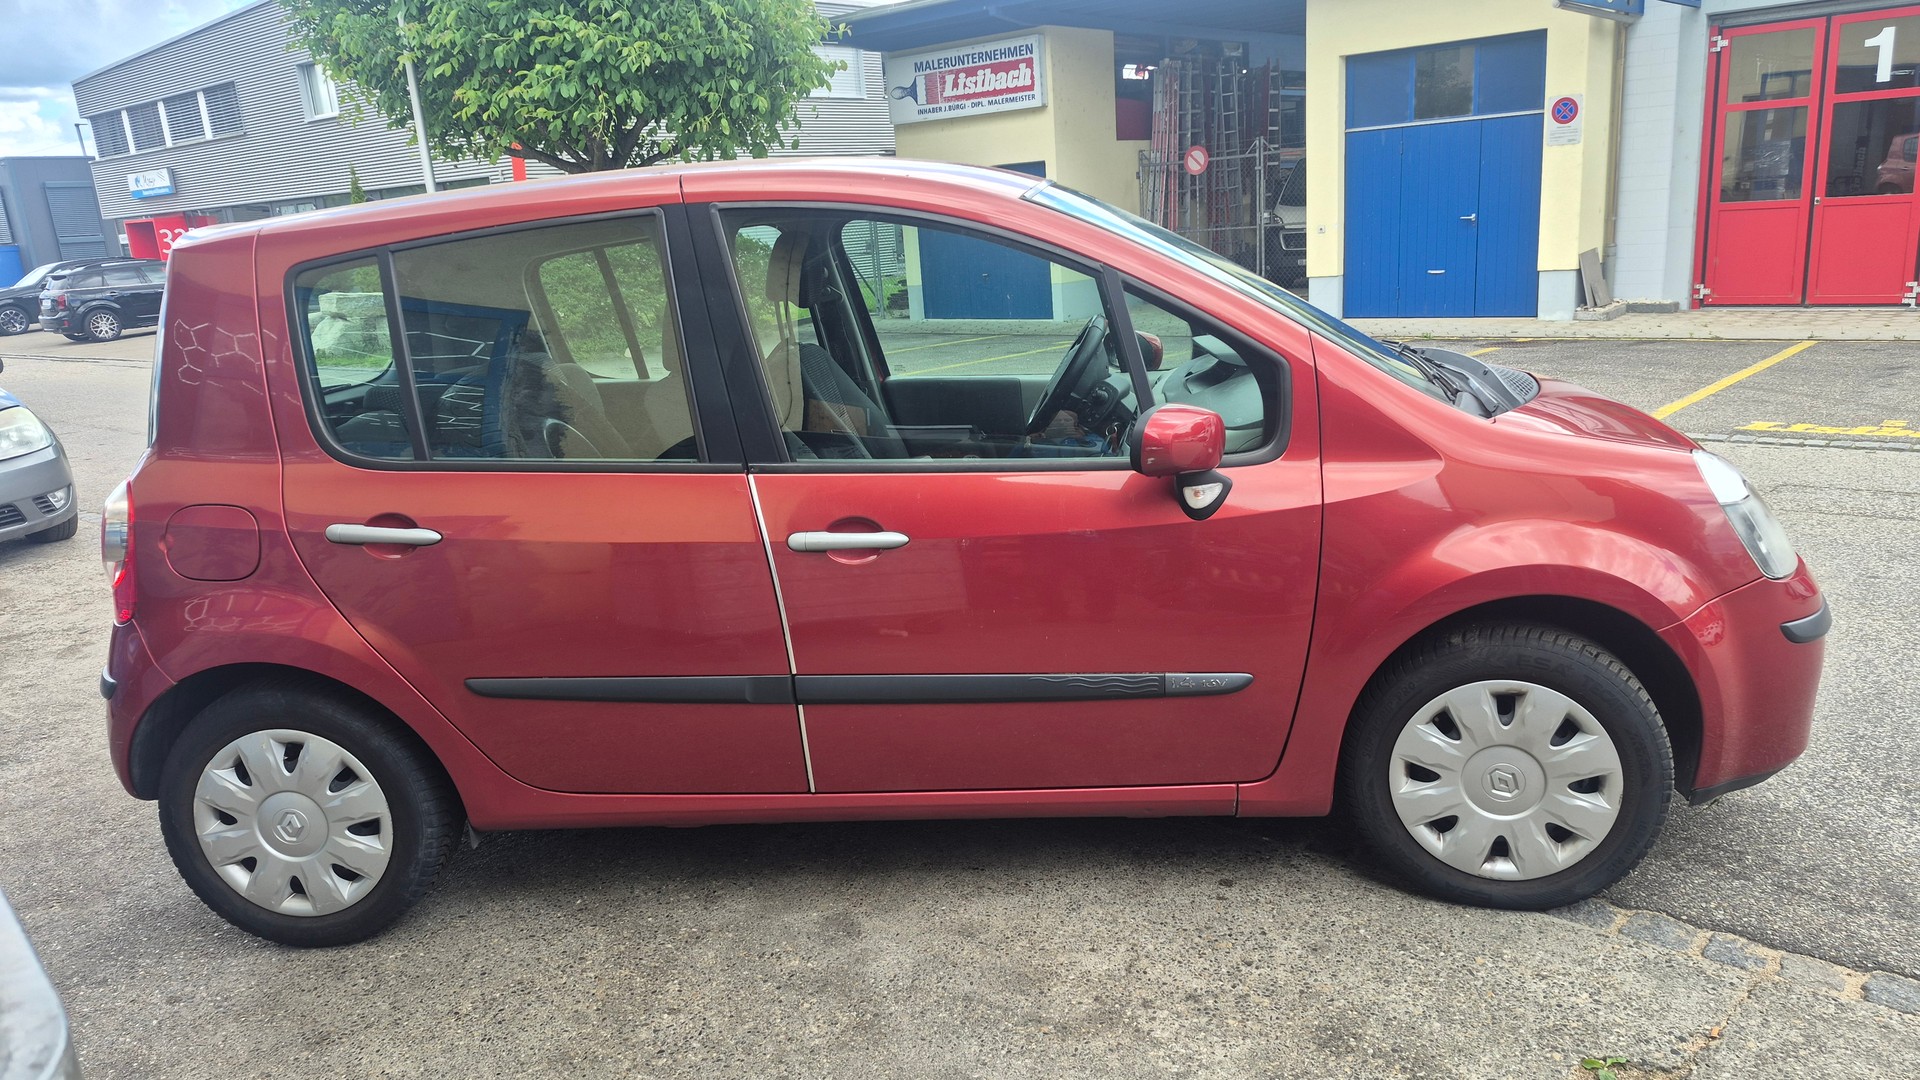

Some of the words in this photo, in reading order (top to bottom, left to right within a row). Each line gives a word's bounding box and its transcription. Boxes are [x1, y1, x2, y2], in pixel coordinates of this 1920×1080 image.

[914, 43, 1034, 73] MALERUNTERNEHMEN
[1864, 26, 1896, 83] 1
[943, 63, 1032, 97] Lisibach
[917, 106, 943, 116] INHABER
[971, 100, 986, 108] DIPL.
[987, 93, 1036, 107] MALERMEISTER
